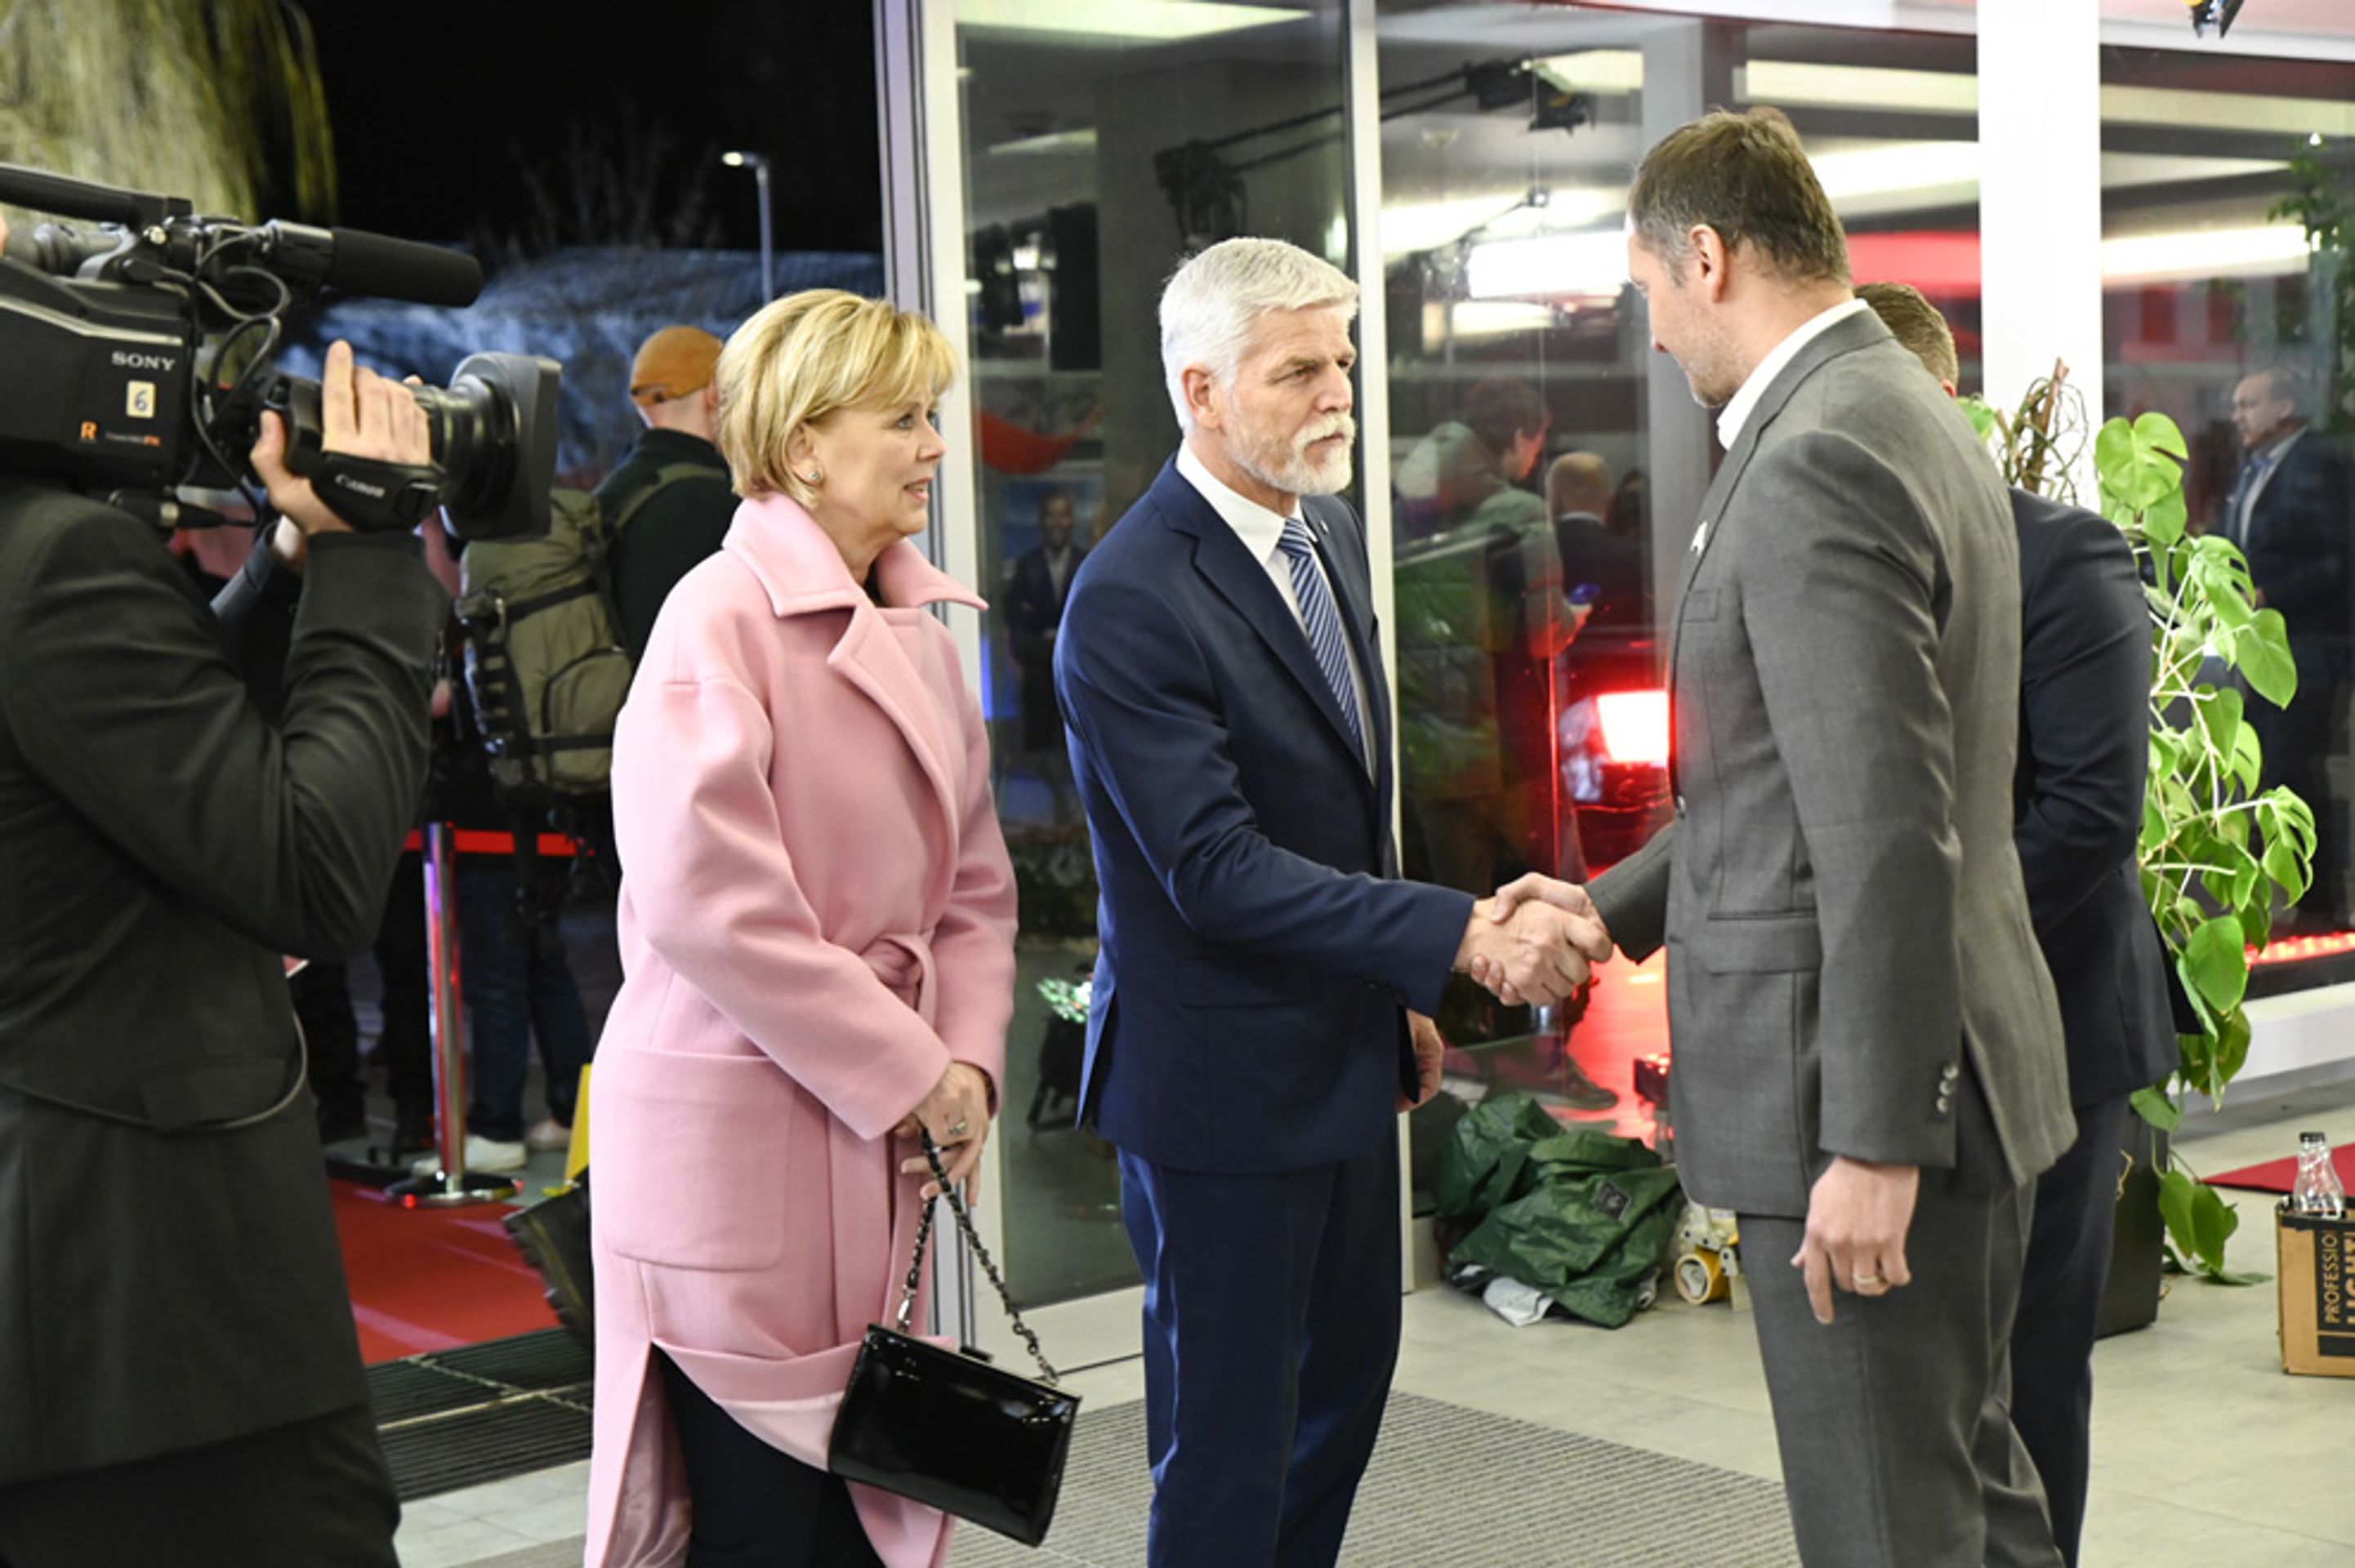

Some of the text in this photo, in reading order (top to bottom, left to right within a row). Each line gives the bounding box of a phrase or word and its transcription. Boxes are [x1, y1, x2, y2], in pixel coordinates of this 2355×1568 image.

[112, 351, 175, 371] SONY
[134, 390, 148, 412] 6
[81, 421, 97, 440] R
[334, 474, 386, 498] Canon
